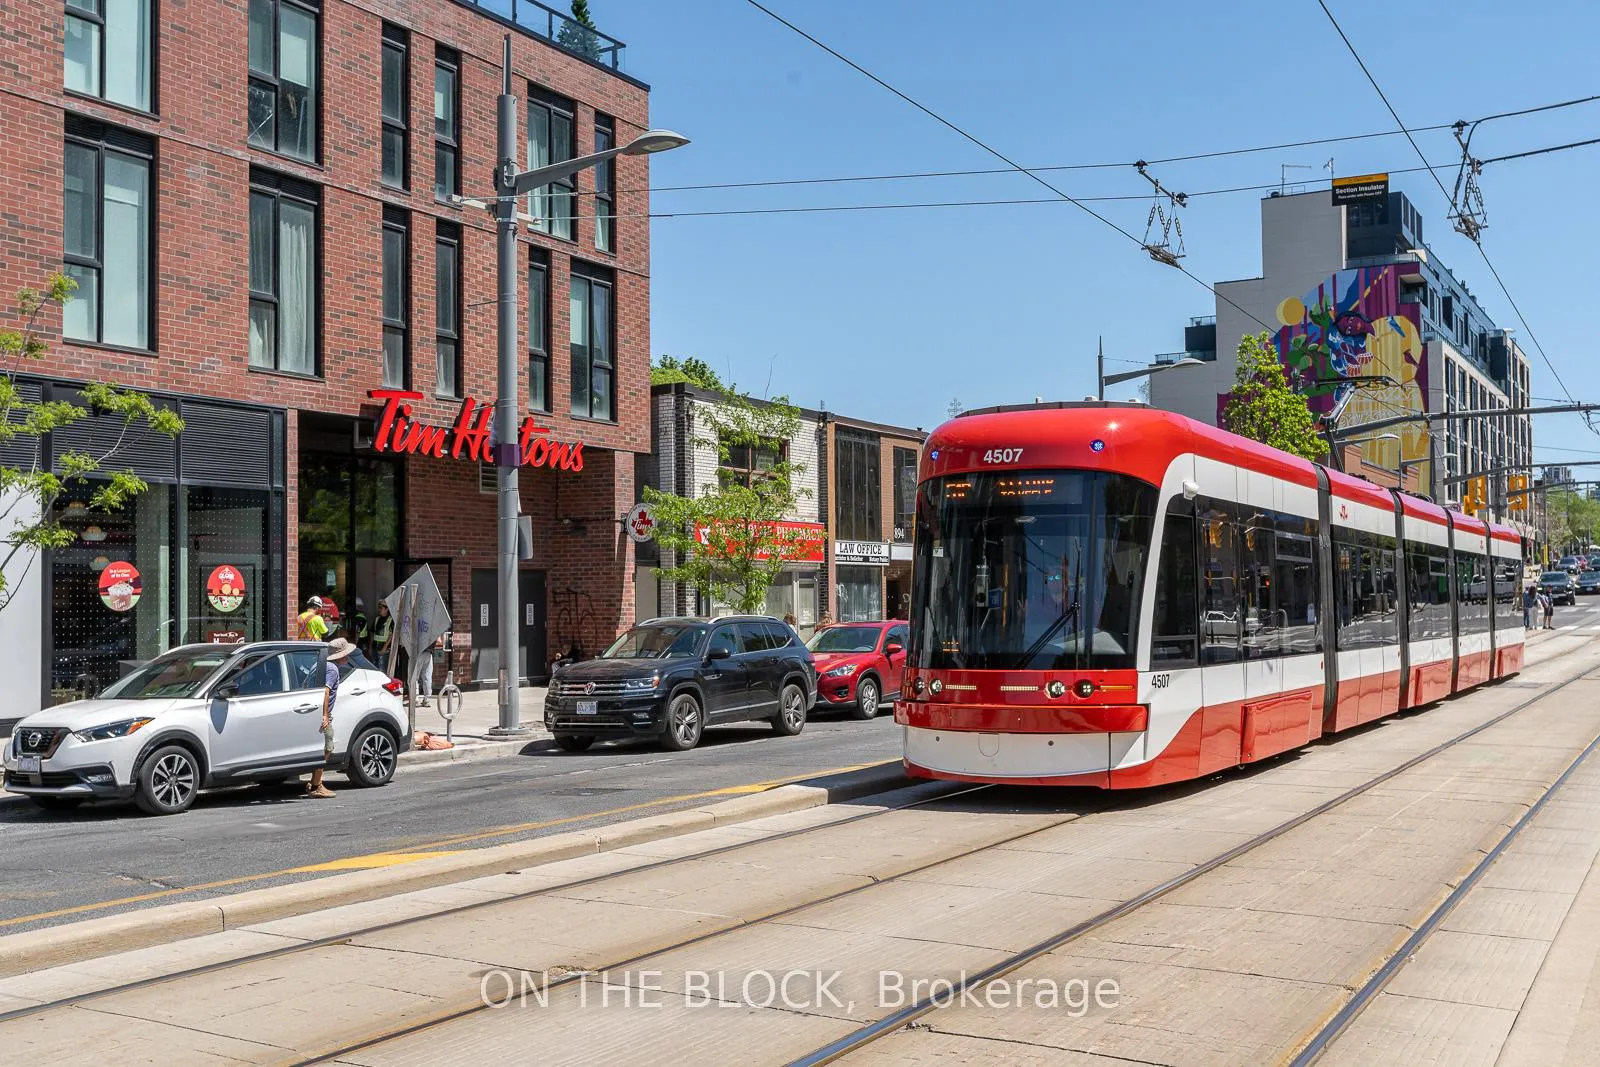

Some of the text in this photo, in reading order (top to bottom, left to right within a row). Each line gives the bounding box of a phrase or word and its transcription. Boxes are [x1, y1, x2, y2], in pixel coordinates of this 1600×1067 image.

[1335, 184, 1385, 195] Section Insulator
[368, 388, 584, 472] Tim Htons
[983, 448, 1024, 464] 4507
[839, 542, 882, 555] LAW OFFICE
[1151, 673, 1170, 689] 4507
